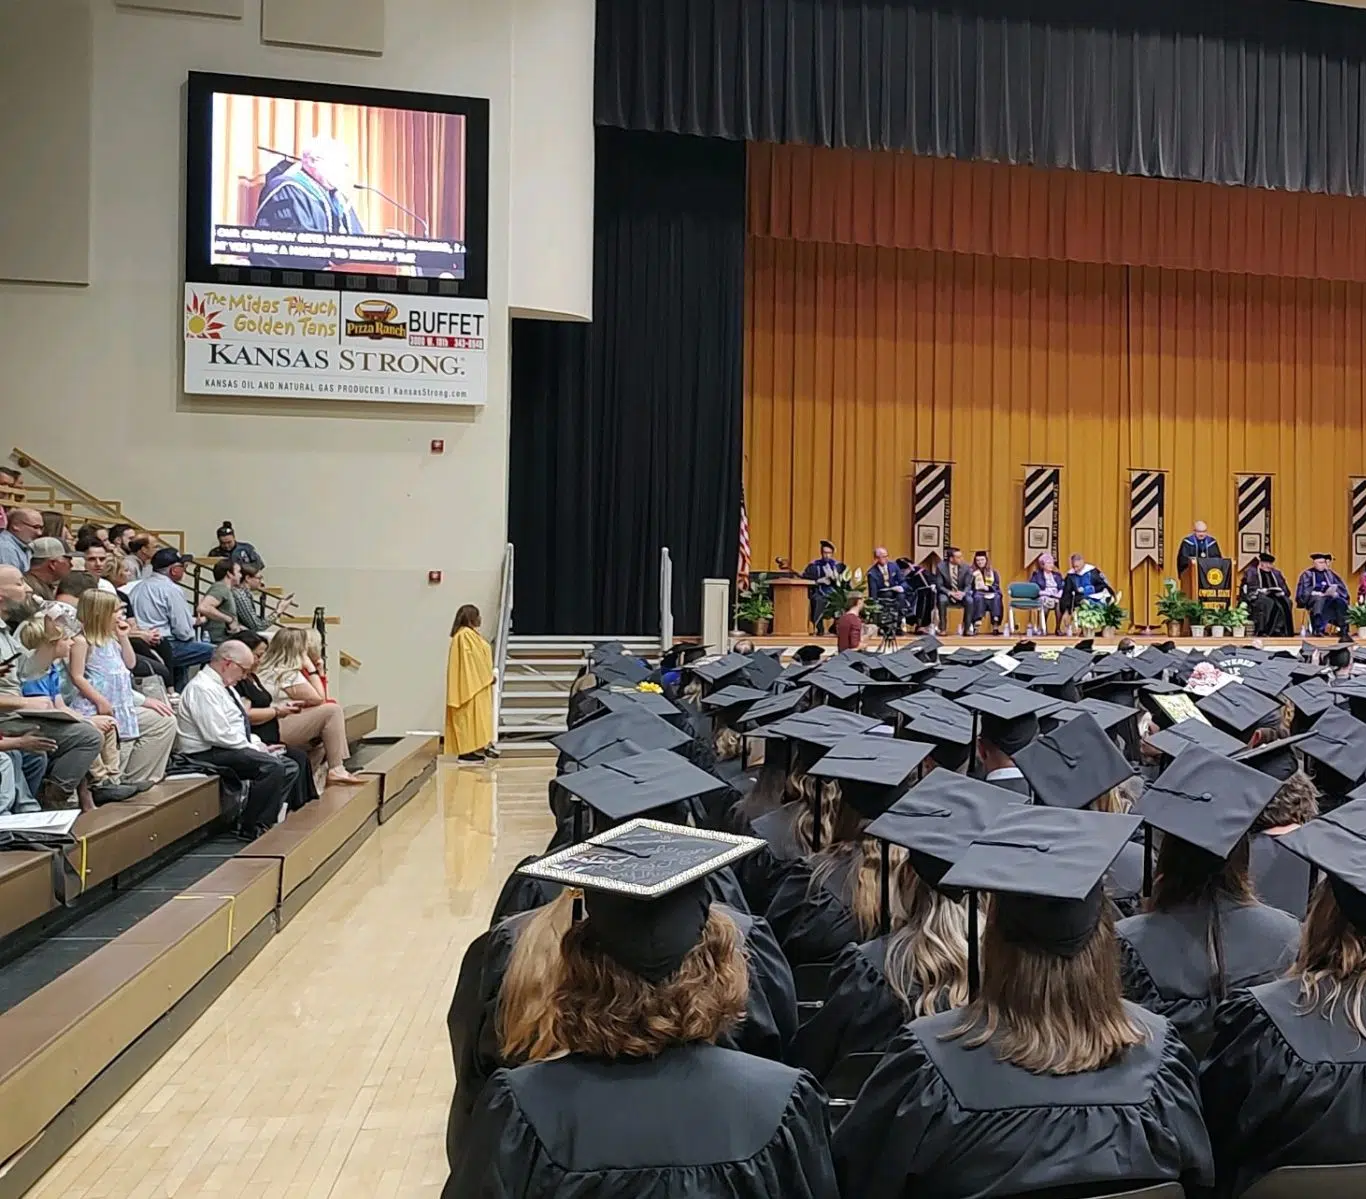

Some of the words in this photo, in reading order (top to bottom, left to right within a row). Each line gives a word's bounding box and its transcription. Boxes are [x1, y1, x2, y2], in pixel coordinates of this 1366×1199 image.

[204, 292, 227, 306] The
[228, 294, 280, 314] Midas
[283, 295, 337, 316] Touch
[233, 314, 295, 336] Golden
[298, 317, 337, 337] Tans
[347, 321, 375, 335] Pizza
[375, 321, 406, 337] Ranch
[409, 310, 484, 336] BUFFET
[208, 343, 330, 370] KANSAS
[205, 378, 238, 389] KANSAS
[241, 380, 255, 389] OIL
[258, 380, 274, 390] AND
[278, 381, 315, 392] NATURAL
[318, 383, 334, 392] GAS
[337, 384, 385, 395] PRODUCERS
[393, 387, 467, 399] KansasStrong.com
